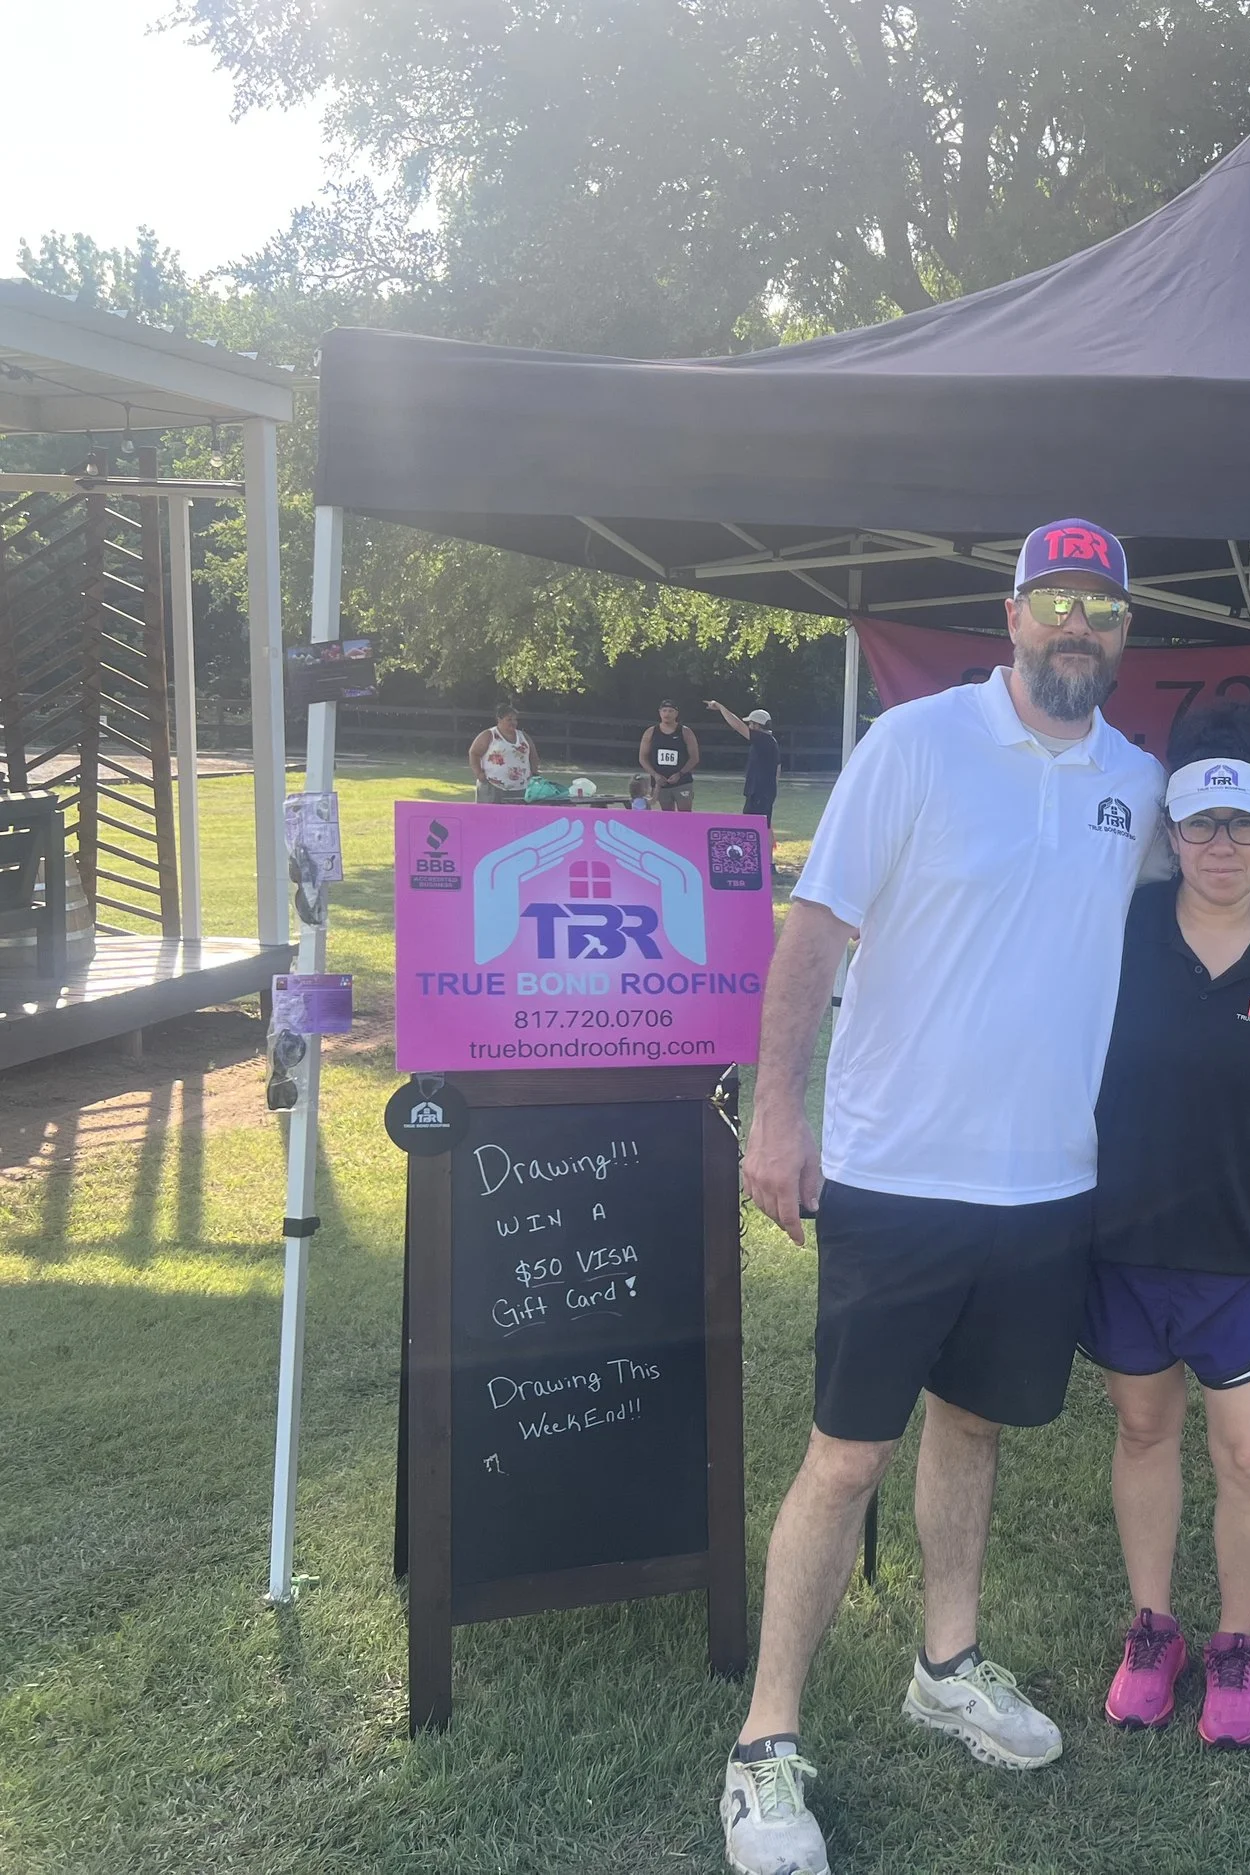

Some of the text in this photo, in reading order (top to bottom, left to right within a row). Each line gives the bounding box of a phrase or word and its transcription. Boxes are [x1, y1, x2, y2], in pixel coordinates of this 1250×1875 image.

[1044, 527, 1111, 569] TBR
[660, 752, 675, 762] 166
[416, 859, 455, 873] BBB
[520, 903, 663, 960] TBR
[416, 972, 761, 996] TRUE BOND ROOFING
[514, 1008, 673, 1030] 817.720.0706
[469, 1037, 715, 1061] truebondroofing.com
[474, 1141, 639, 1196] Drawing!!!
[497, 1202, 607, 1237] WIN A
[515, 1244, 638, 1288] $50 VISA
[492, 1297, 548, 1329] Gift
[487, 1358, 661, 1410] Drawing This
